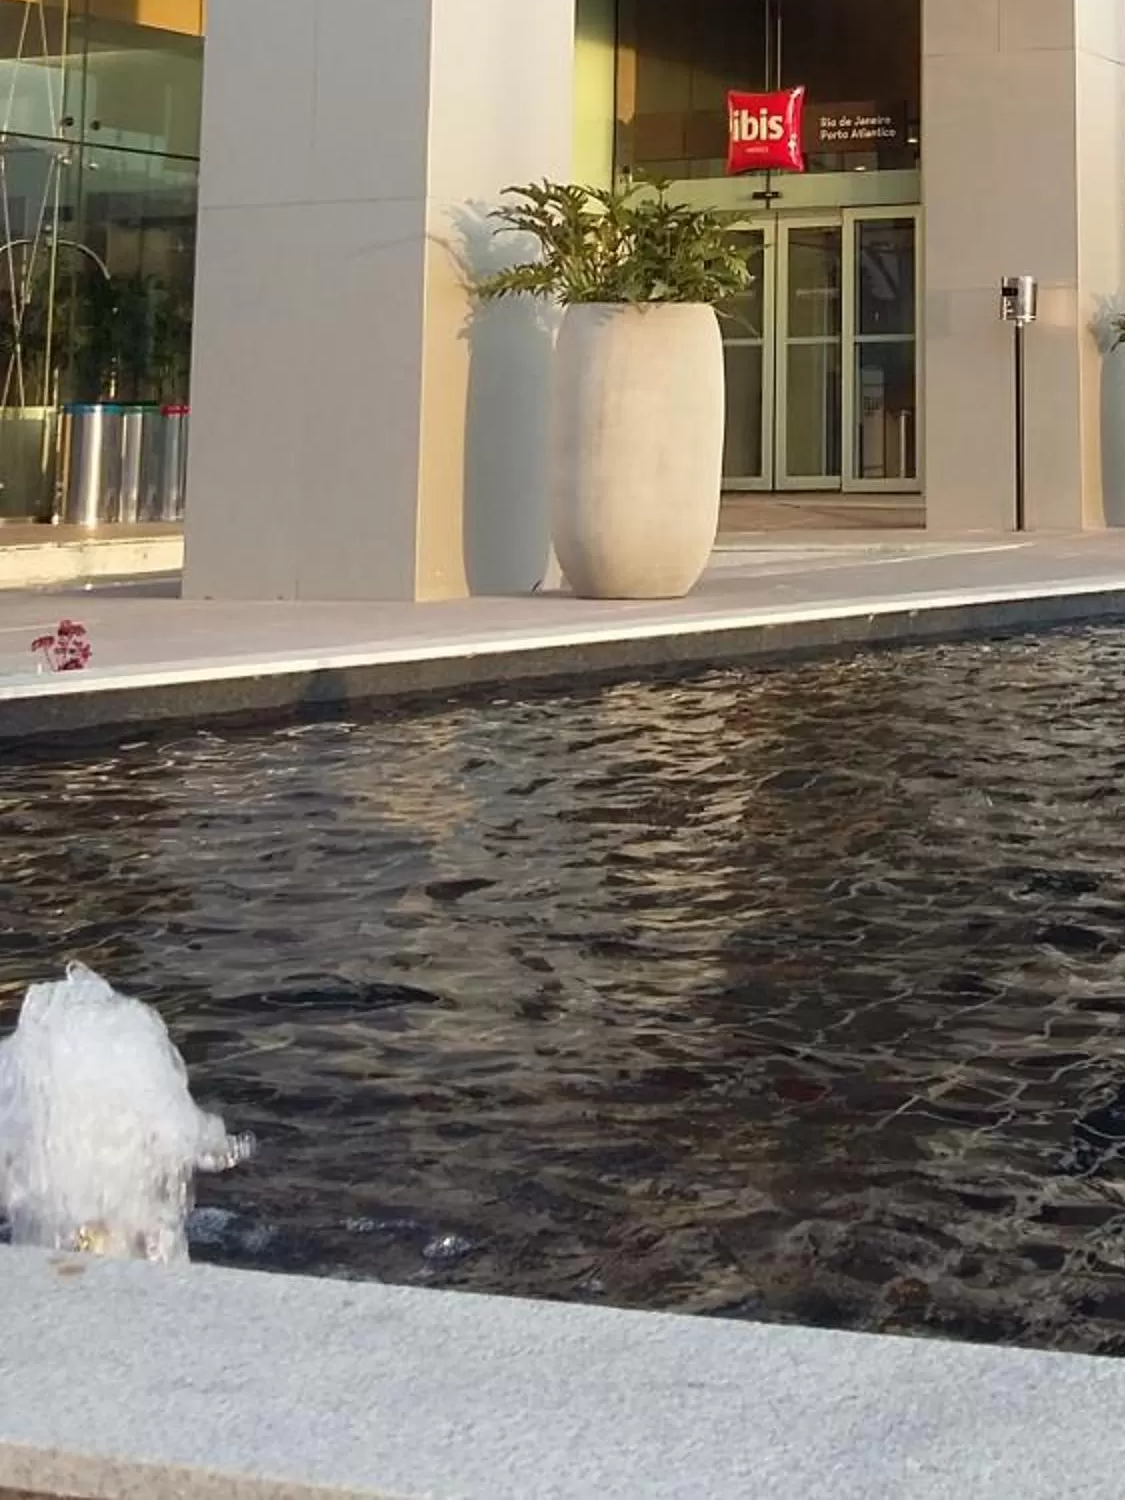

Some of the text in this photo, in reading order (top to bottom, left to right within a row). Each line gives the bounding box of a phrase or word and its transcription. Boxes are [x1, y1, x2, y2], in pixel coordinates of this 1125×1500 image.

[733, 108, 784, 141] ibis
[820, 115, 891, 126] Rio de Janeiro
[820, 129, 849, 139] Porto
